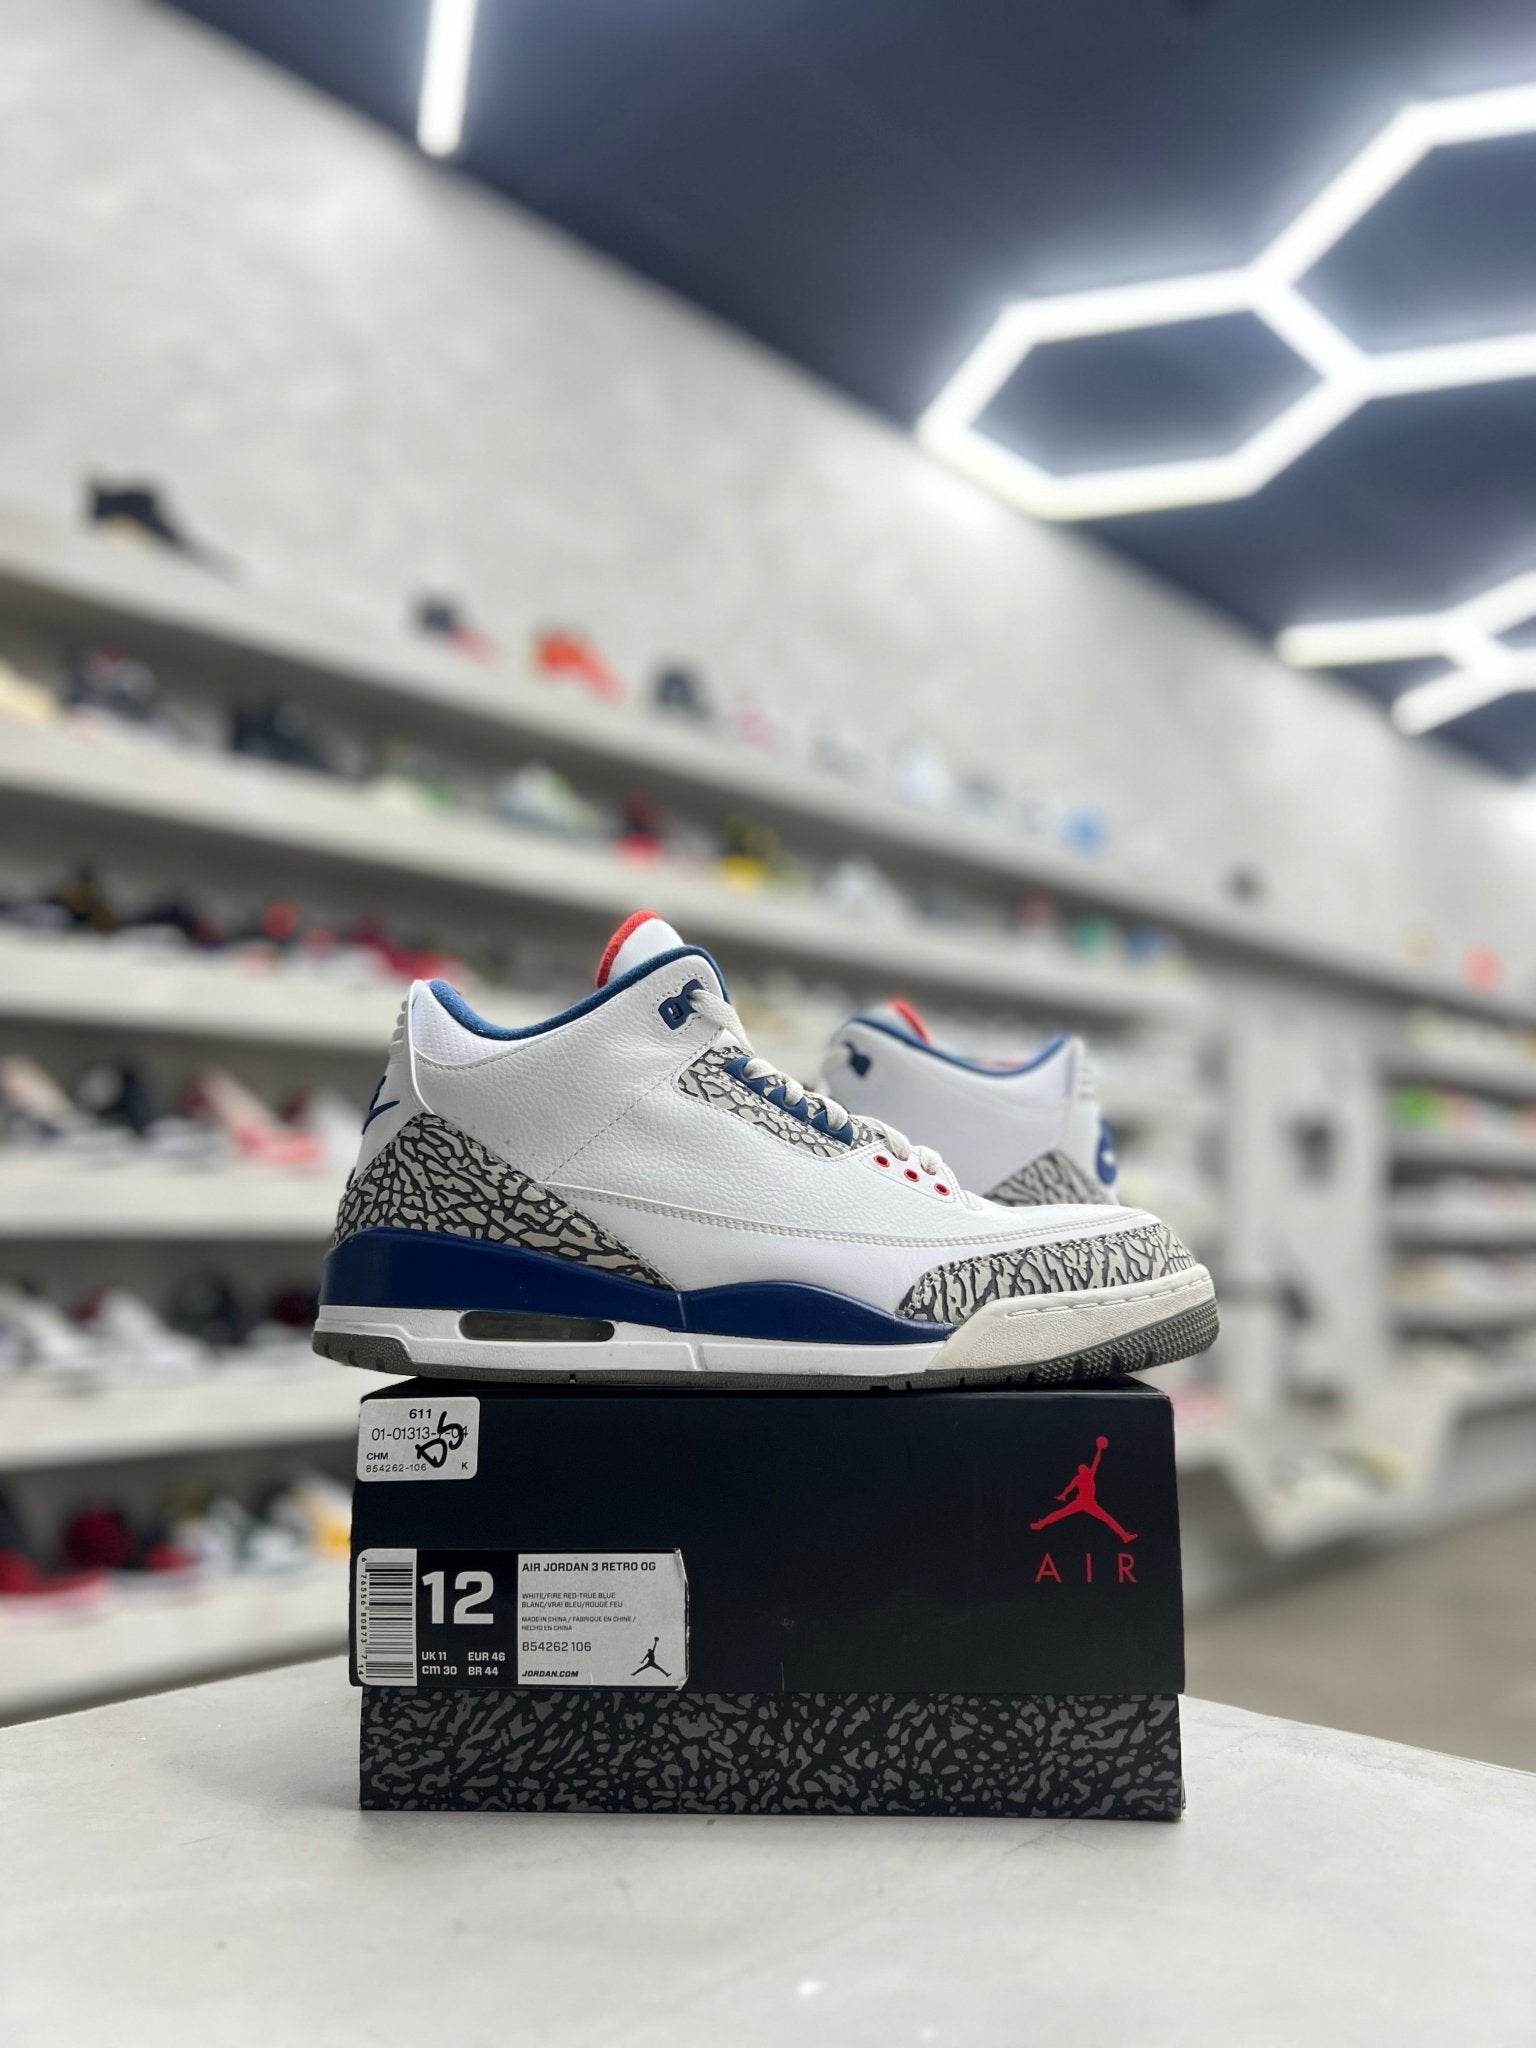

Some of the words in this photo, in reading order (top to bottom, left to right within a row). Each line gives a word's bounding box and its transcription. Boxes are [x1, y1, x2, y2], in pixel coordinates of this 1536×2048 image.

[409, 1408, 432, 1419] 611
[366, 1452, 389, 1461] CHM
[365, 1463, 427, 1473] 854262-106
[461, 1461, 468, 1470] K
[522, 1562, 541, 1572] AIR
[543, 1562, 589, 1572] JORDAN
[591, 1562, 599, 1571] 3
[602, 1562, 638, 1571] RETRO
[640, 1562, 656, 1571] OG
[1034, 1552, 1138, 1583] AIR
[360, 1574, 368, 1606] 76556
[421, 1571, 494, 1624] 12
[521, 1592, 562, 1600] WHITE/FIRE
[563, 1592, 597, 1600] RED-TRUE
[598, 1592, 616, 1600] BLUE
[360, 1612, 368, 1643] 80873
[421, 1651, 436, 1661] UK
[438, 1651, 447, 1661] 11
[468, 1652, 489, 1661] EUR
[491, 1652, 506, 1662] 46
[443, 1666, 458, 1675] 30
[468, 1666, 482, 1676] BR
[484, 1666, 499, 1676] 44
[522, 1670, 579, 1678] JORDAN.COM
